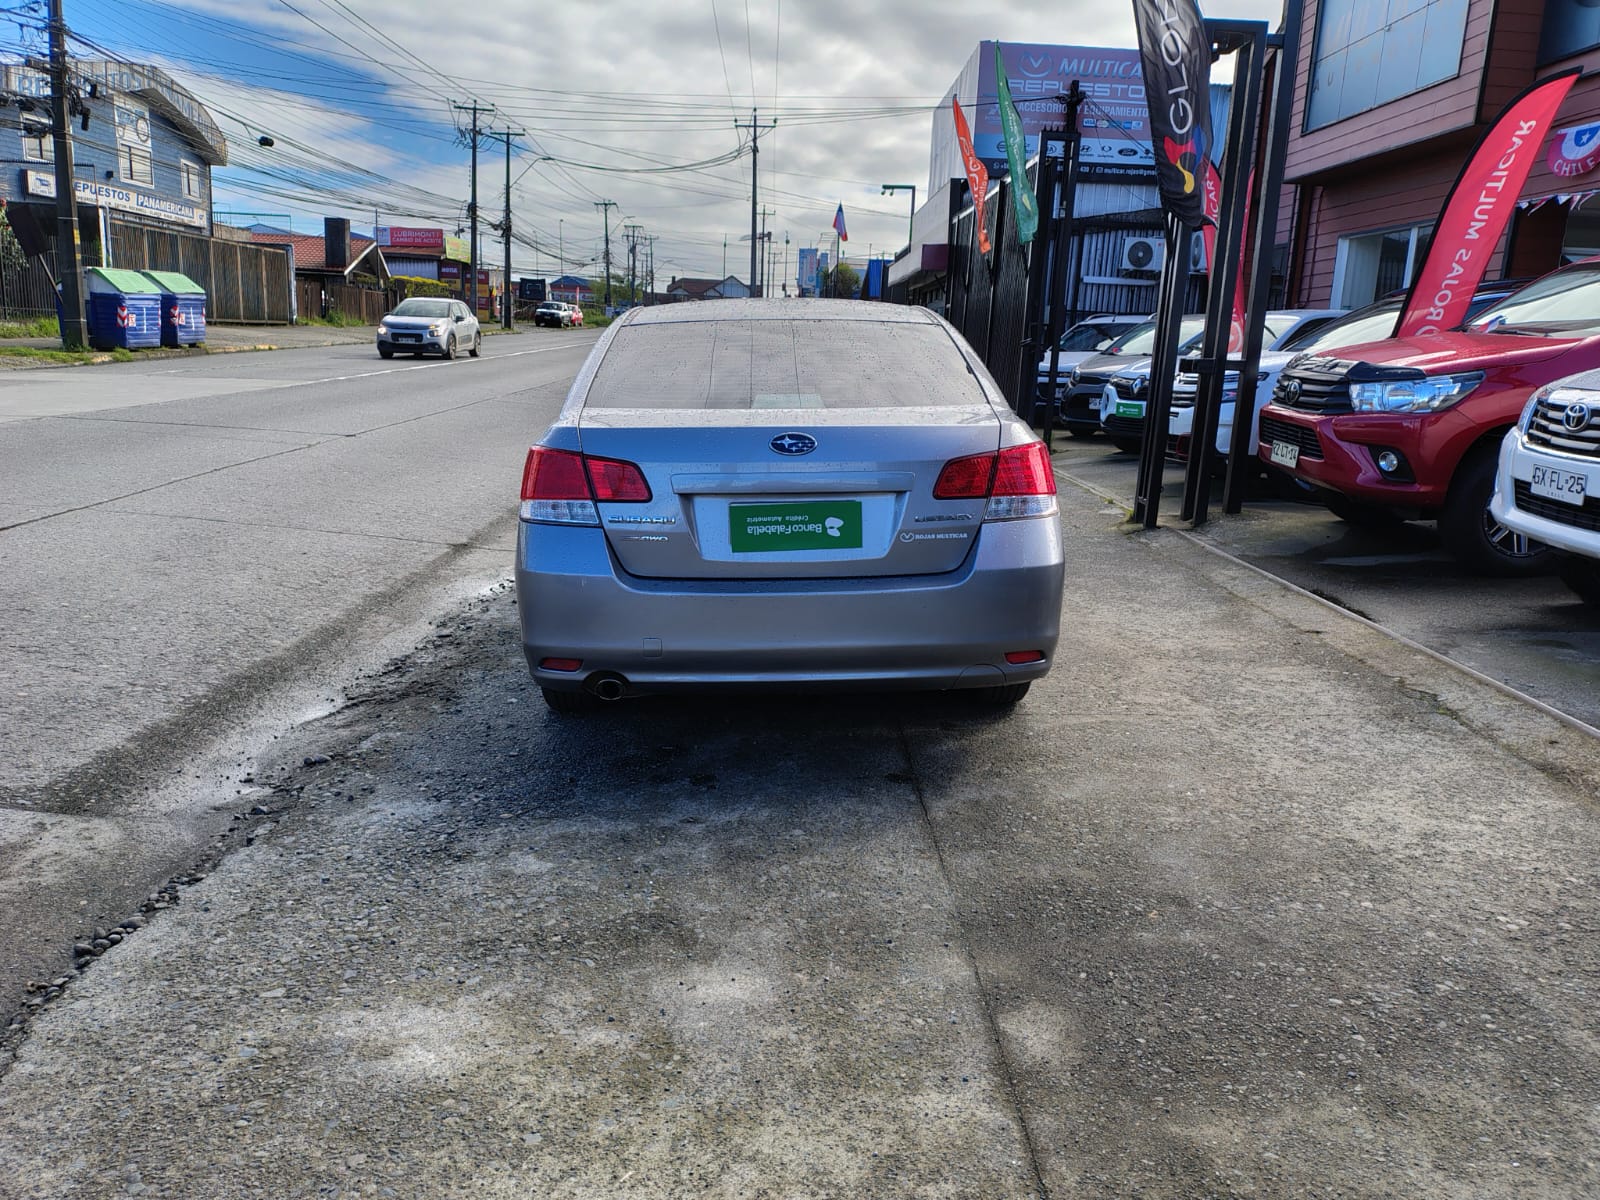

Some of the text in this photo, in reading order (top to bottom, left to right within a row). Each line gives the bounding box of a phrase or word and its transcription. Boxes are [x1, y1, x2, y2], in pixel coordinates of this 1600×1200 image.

[1058, 57, 1143, 79] MULTICA
[1007, 79, 1145, 98] REPUESTO
[1019, 103, 1067, 114] ACCESORIO
[1553, 156, 1596, 177] CHILE
[74, 180, 131, 201] EPUESTOS
[138, 194, 193, 218] PANAMERICANA
[607, 515, 676, 524] SUBARU
[747, 523, 822, 536] Banco Falabella
